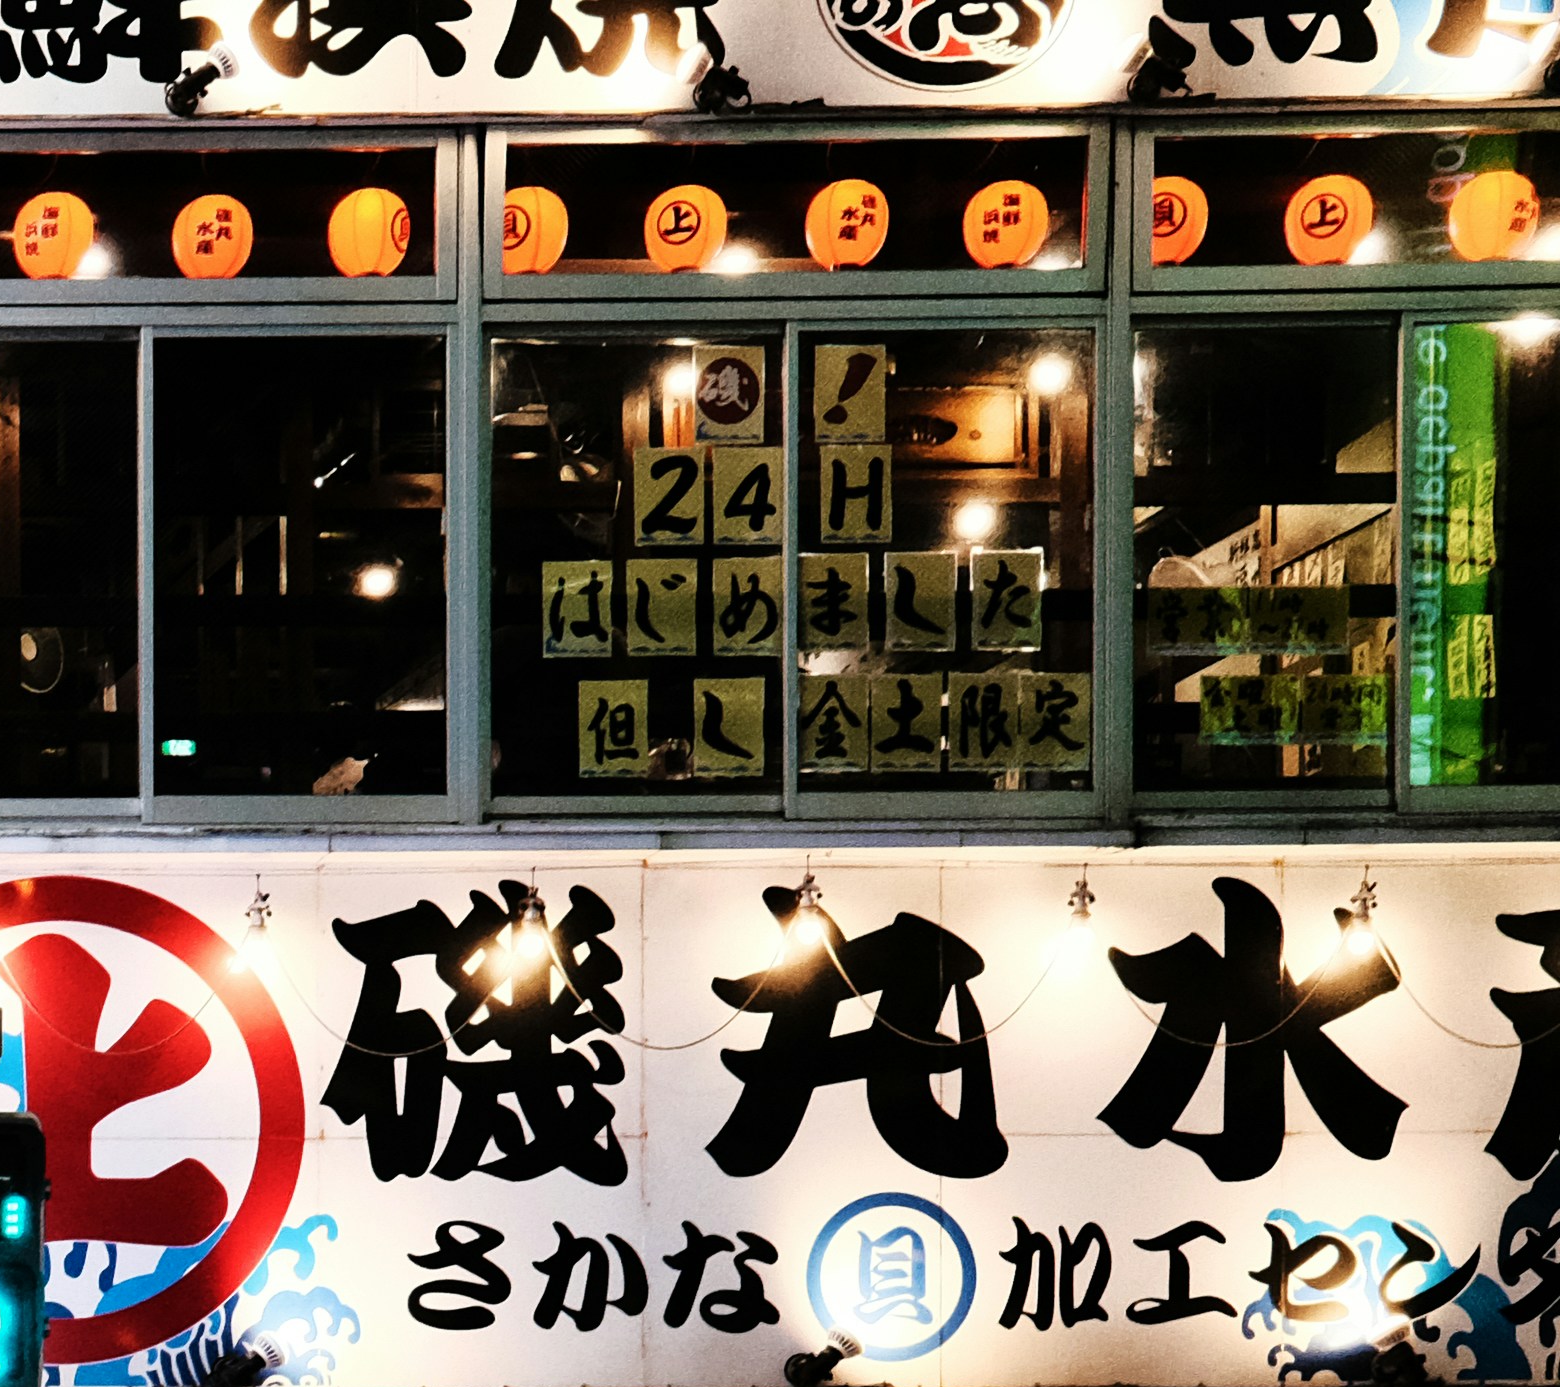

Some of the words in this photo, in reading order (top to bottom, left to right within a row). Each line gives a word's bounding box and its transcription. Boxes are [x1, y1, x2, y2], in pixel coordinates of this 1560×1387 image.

[663, 207, 694, 238] 上
[1307, 198, 1341, 229] 上
[547, 561, 1043, 649] はじめました
[587, 685, 755, 777] 但し
[800, 677, 1088, 772] 金土限定
[321, 876, 1560, 1187] 磯丸水
[407, 1217, 782, 1333] さかな
